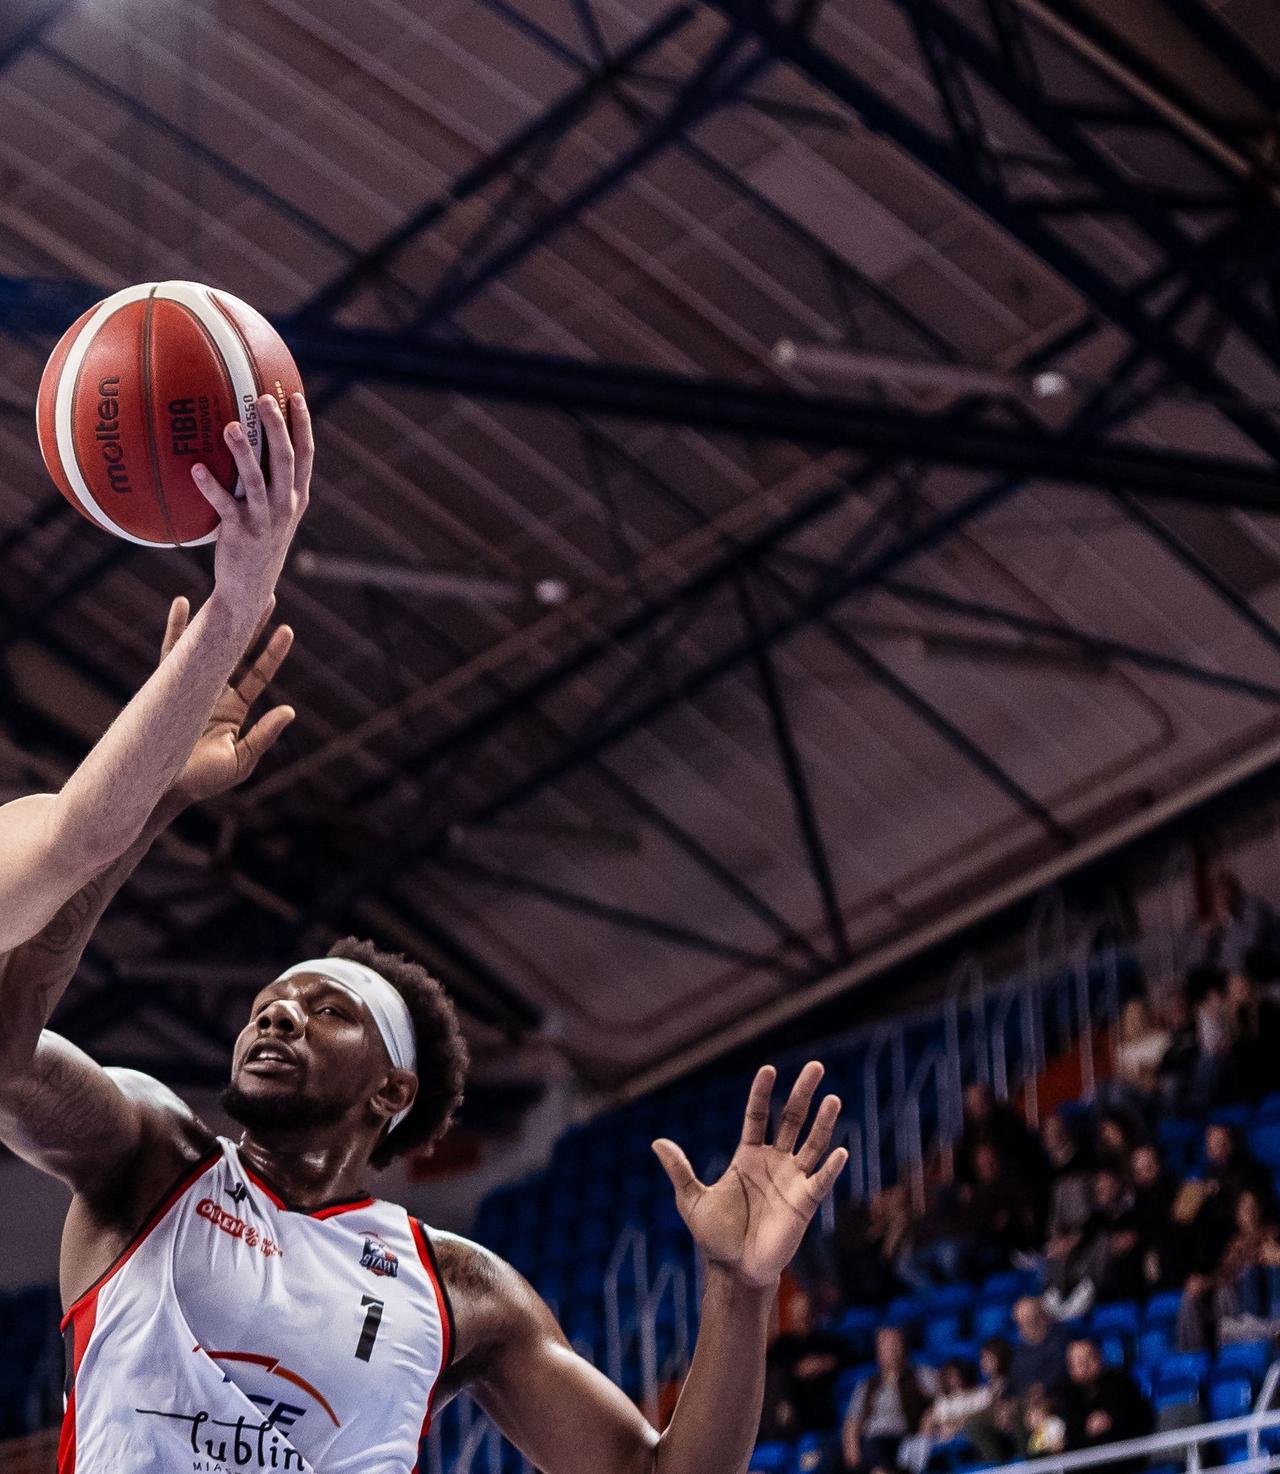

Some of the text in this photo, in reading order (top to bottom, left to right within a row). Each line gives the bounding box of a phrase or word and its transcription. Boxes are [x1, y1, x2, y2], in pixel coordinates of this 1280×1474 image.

[96, 376, 132, 494] molten
[168, 398, 199, 456] FIBA
[354, 1295, 384, 1362] 1
